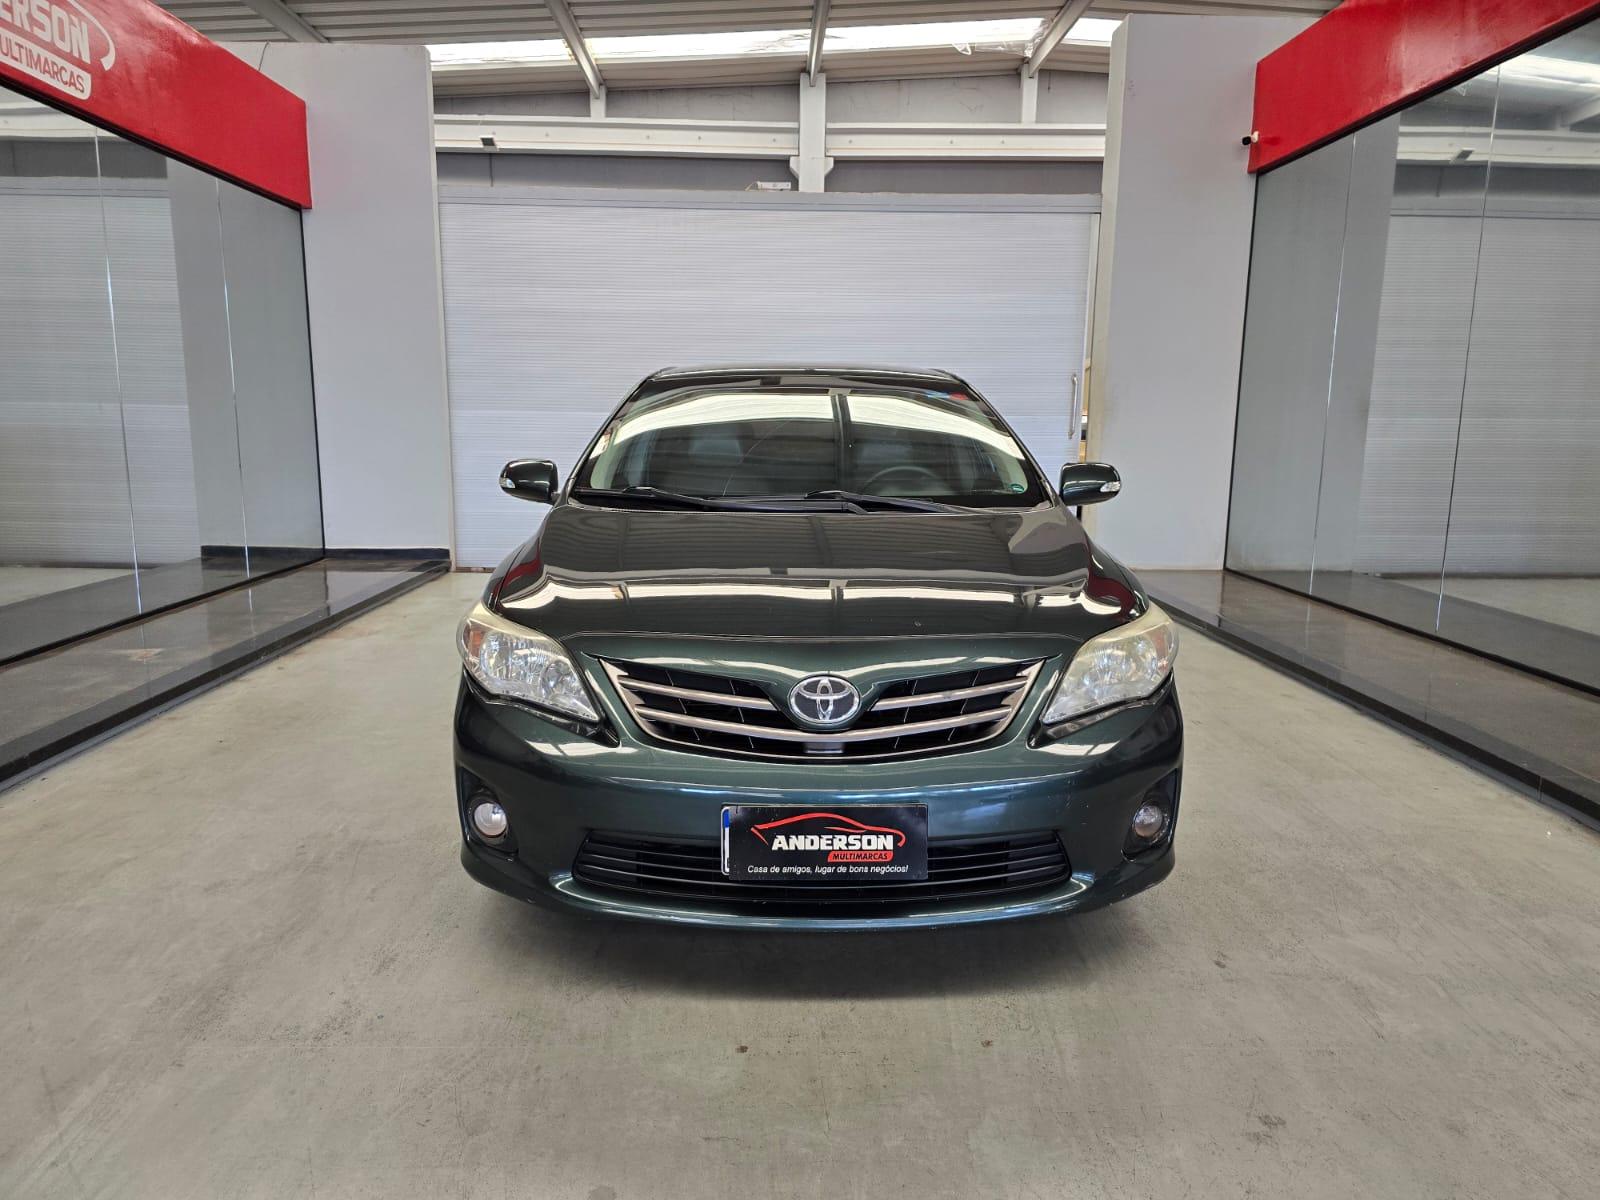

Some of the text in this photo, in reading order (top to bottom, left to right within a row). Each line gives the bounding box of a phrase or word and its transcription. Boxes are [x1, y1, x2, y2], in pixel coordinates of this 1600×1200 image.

[771, 834, 894, 851] ANDERSON
[747, 865, 909, 875] Casa de amigos, lugar de bons negócios!
